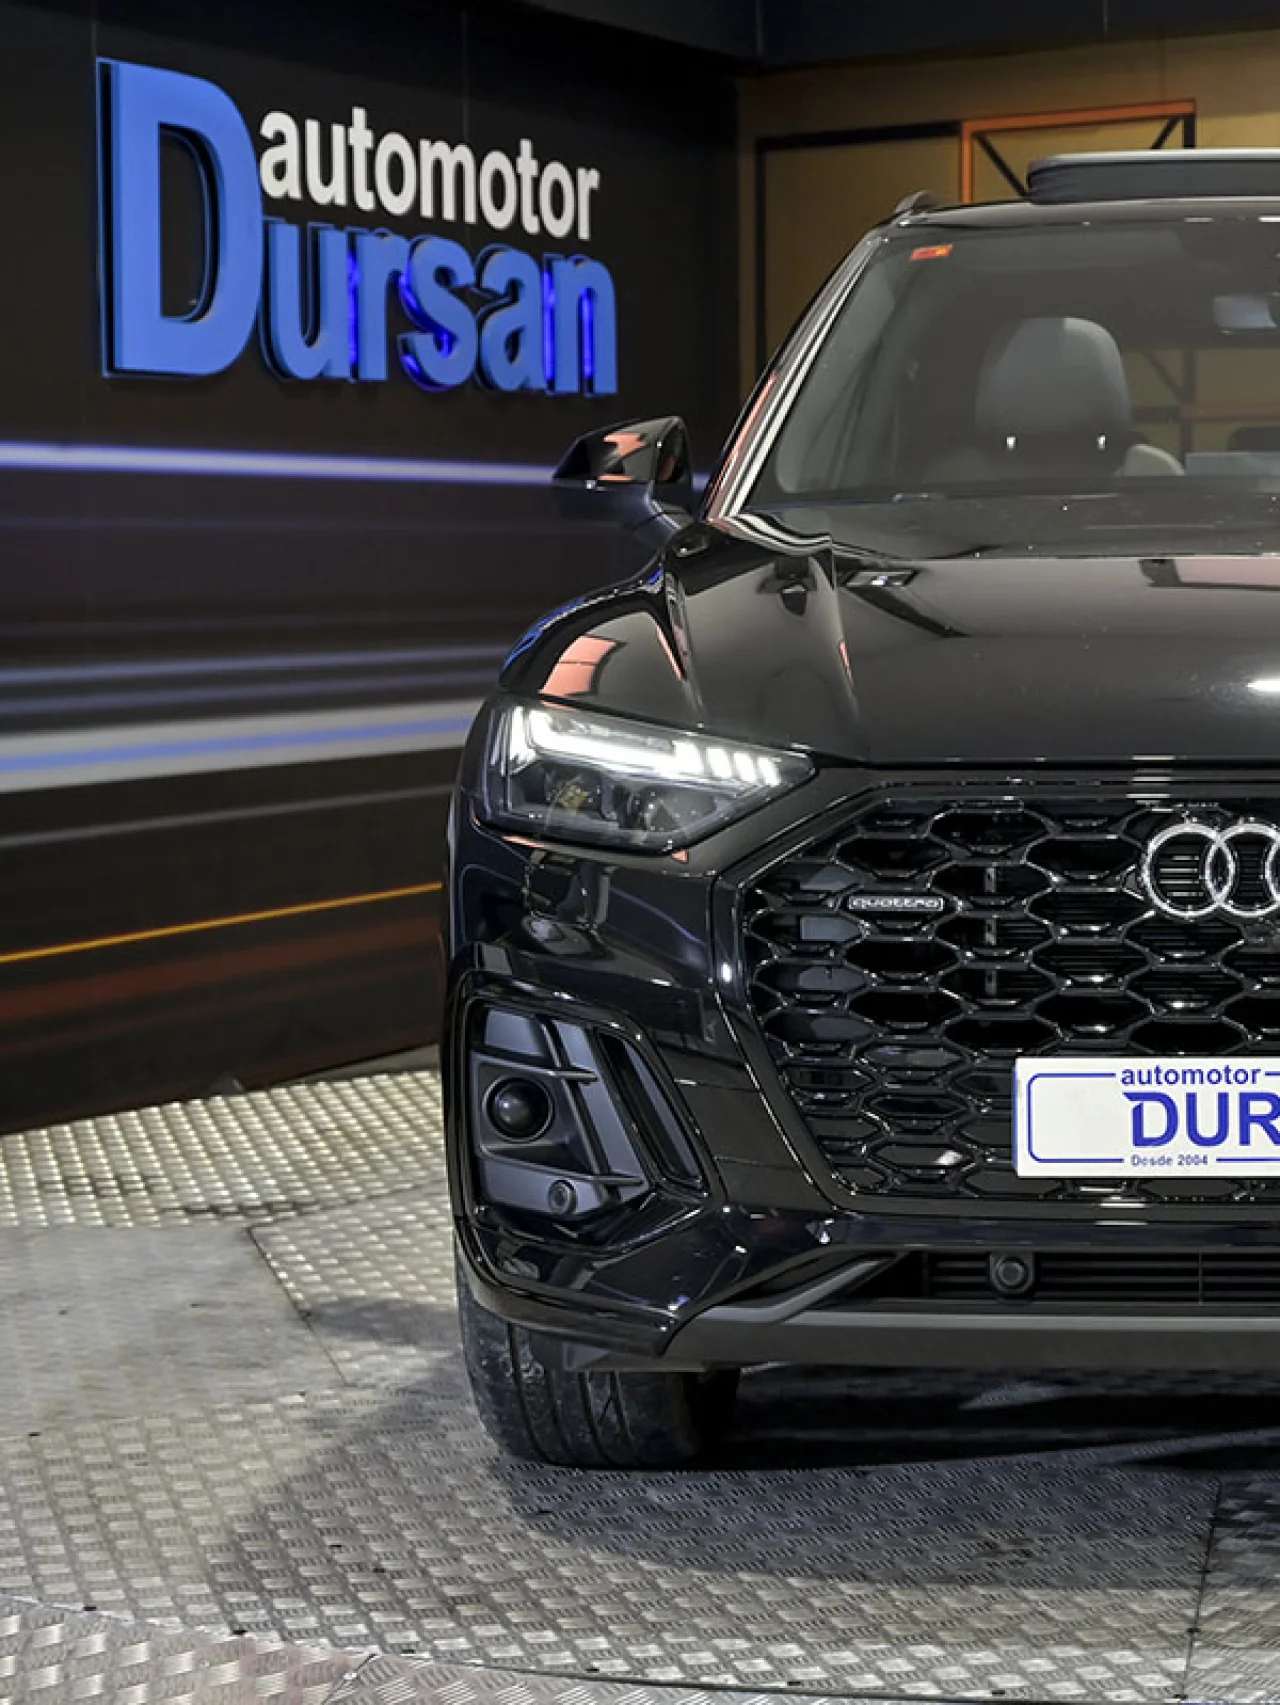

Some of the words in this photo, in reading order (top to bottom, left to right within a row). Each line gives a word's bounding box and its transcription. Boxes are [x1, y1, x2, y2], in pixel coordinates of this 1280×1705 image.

[259, 107, 600, 240] automotor
[96, 56, 618, 397] Dursan
[1121, 1065, 1262, 1085] automotor
[1131, 1153, 1173, 1166] Desde
[1177, 1153, 1208, 1166] 2004
